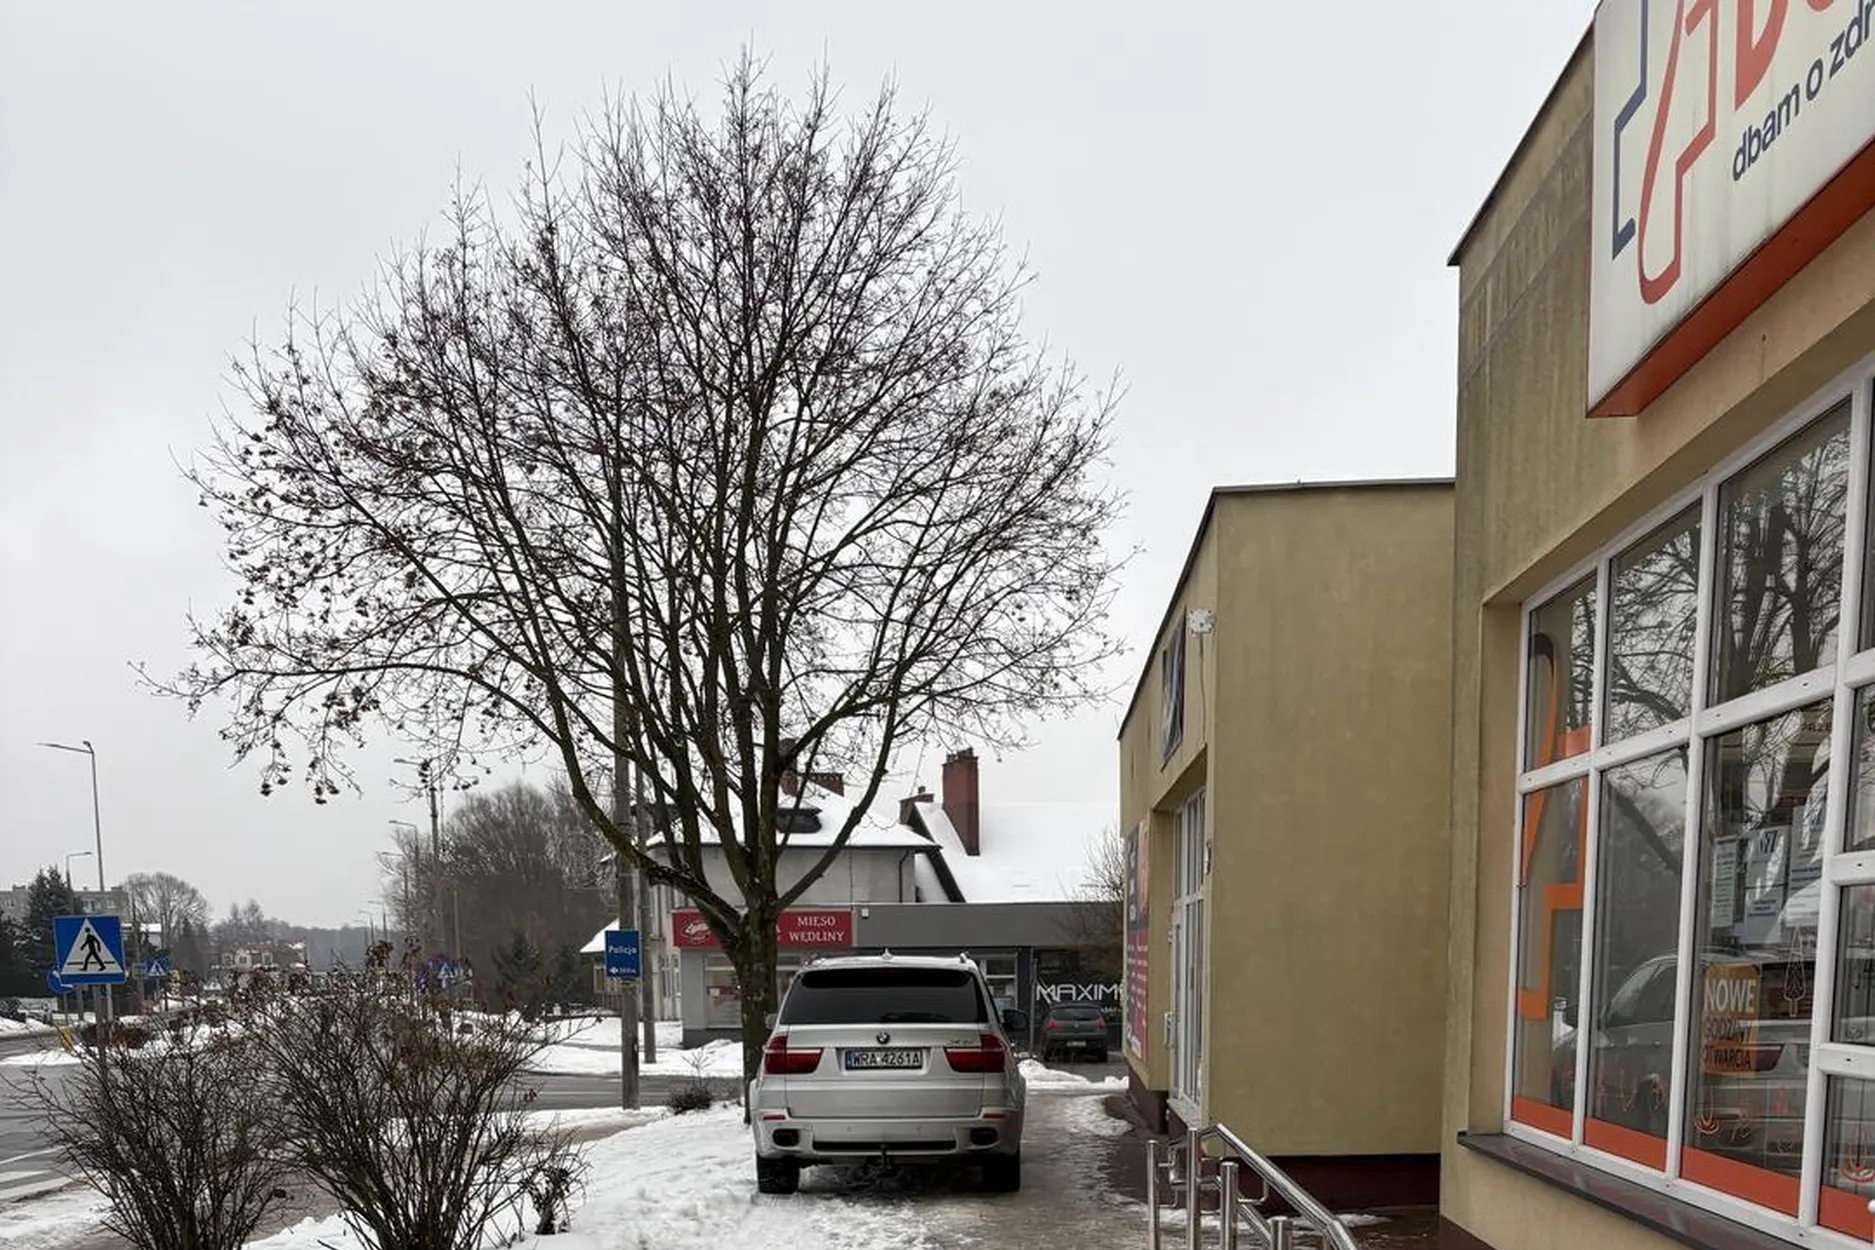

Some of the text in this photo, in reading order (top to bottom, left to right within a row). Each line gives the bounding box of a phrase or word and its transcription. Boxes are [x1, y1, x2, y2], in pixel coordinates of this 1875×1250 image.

[1733, 83, 1800, 181] dbam
[1806, 58, 1824, 101] o
[1704, 978, 1757, 1014] NOWE
